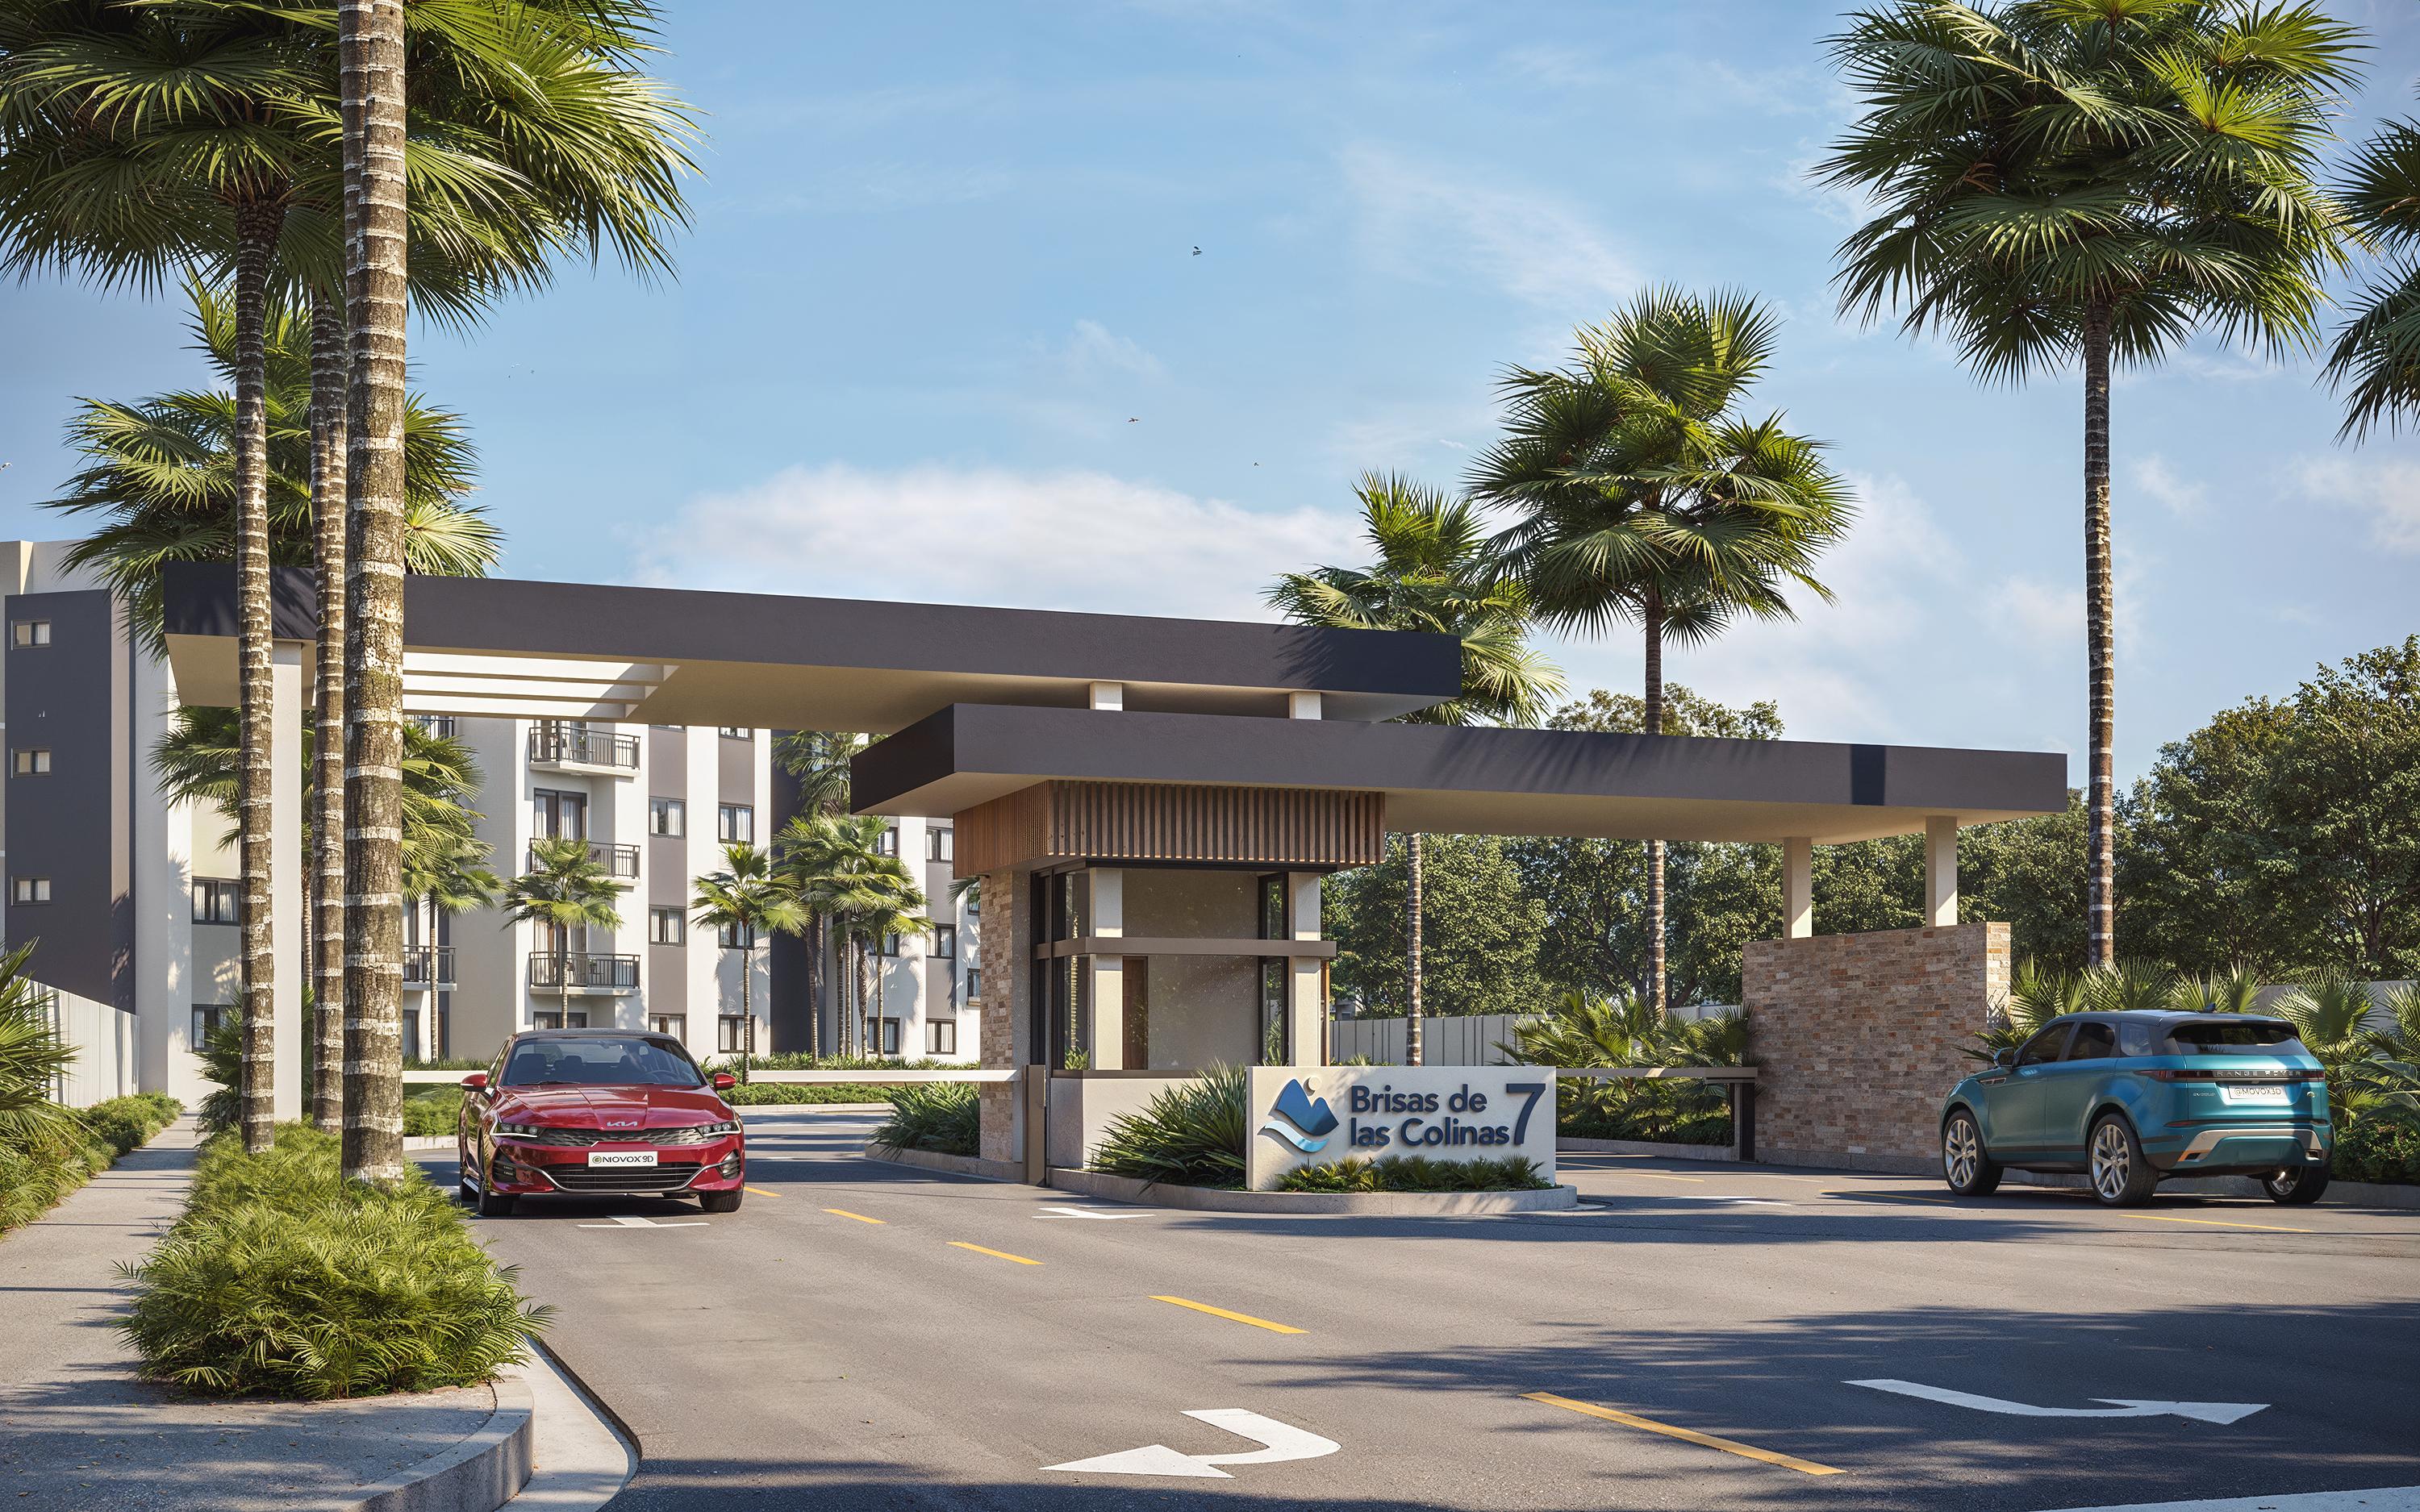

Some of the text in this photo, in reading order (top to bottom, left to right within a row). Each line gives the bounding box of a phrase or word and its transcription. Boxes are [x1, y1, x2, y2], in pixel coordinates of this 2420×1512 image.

[1351, 1083, 1487, 1114] Brisas de
[2234, 1087, 2282, 1096] @MOVOX3D
[1505, 1083, 1546, 1145] 7
[1351, 1116, 1510, 1147] las Colinas
